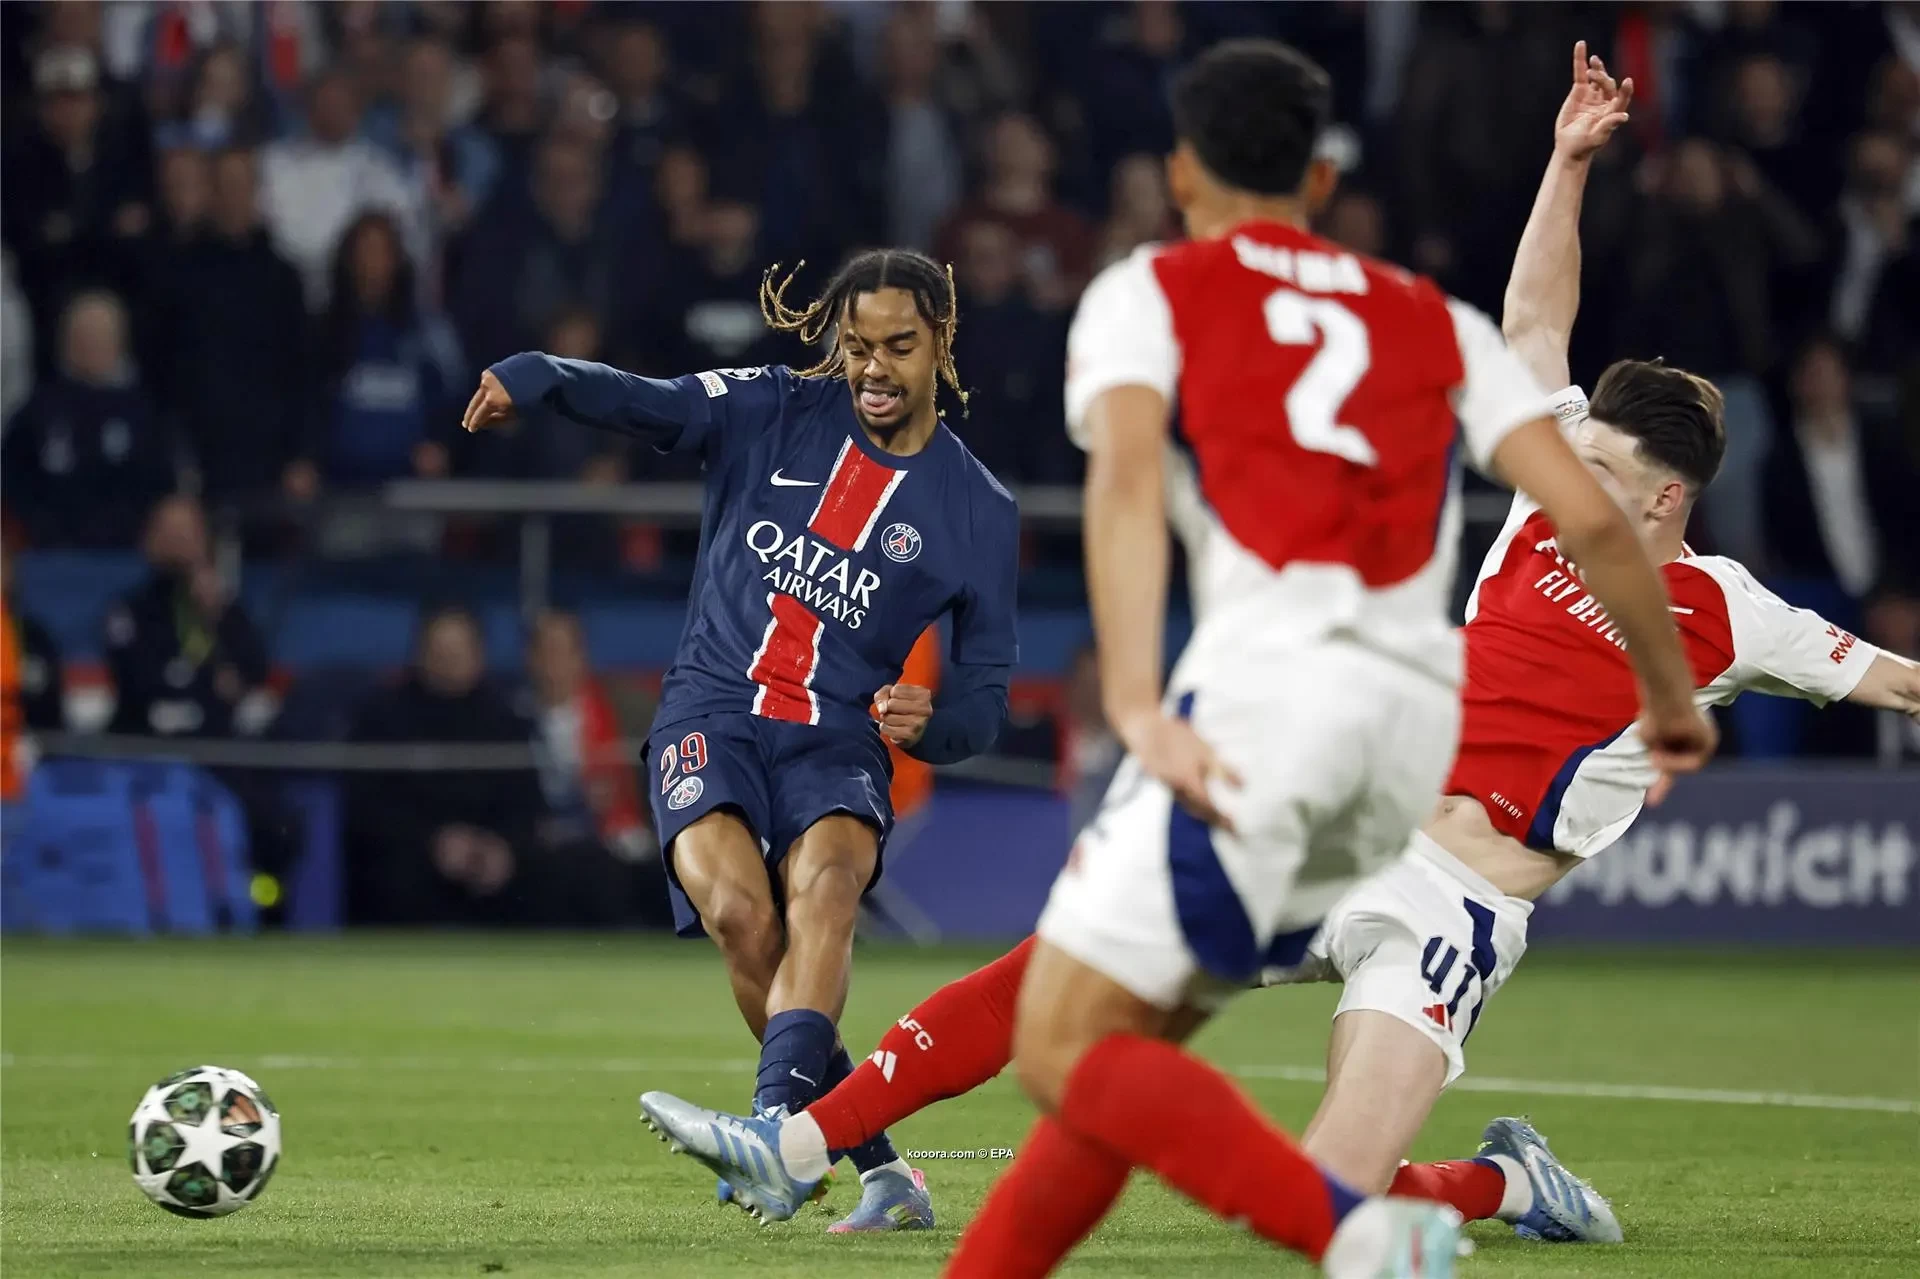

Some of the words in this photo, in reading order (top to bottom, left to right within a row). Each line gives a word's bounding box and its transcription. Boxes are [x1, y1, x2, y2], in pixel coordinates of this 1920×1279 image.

[1263, 287, 1378, 468] 2
[746, 520, 881, 609] QATAR
[894, 525, 919, 543] PARIS
[762, 566, 866, 630] AIRWAYS
[1534, 569, 1580, 603] FLY
[660, 731, 708, 795] 29
[1421, 936, 1478, 1017] 41
[896, 1013, 934, 1051] AFC
